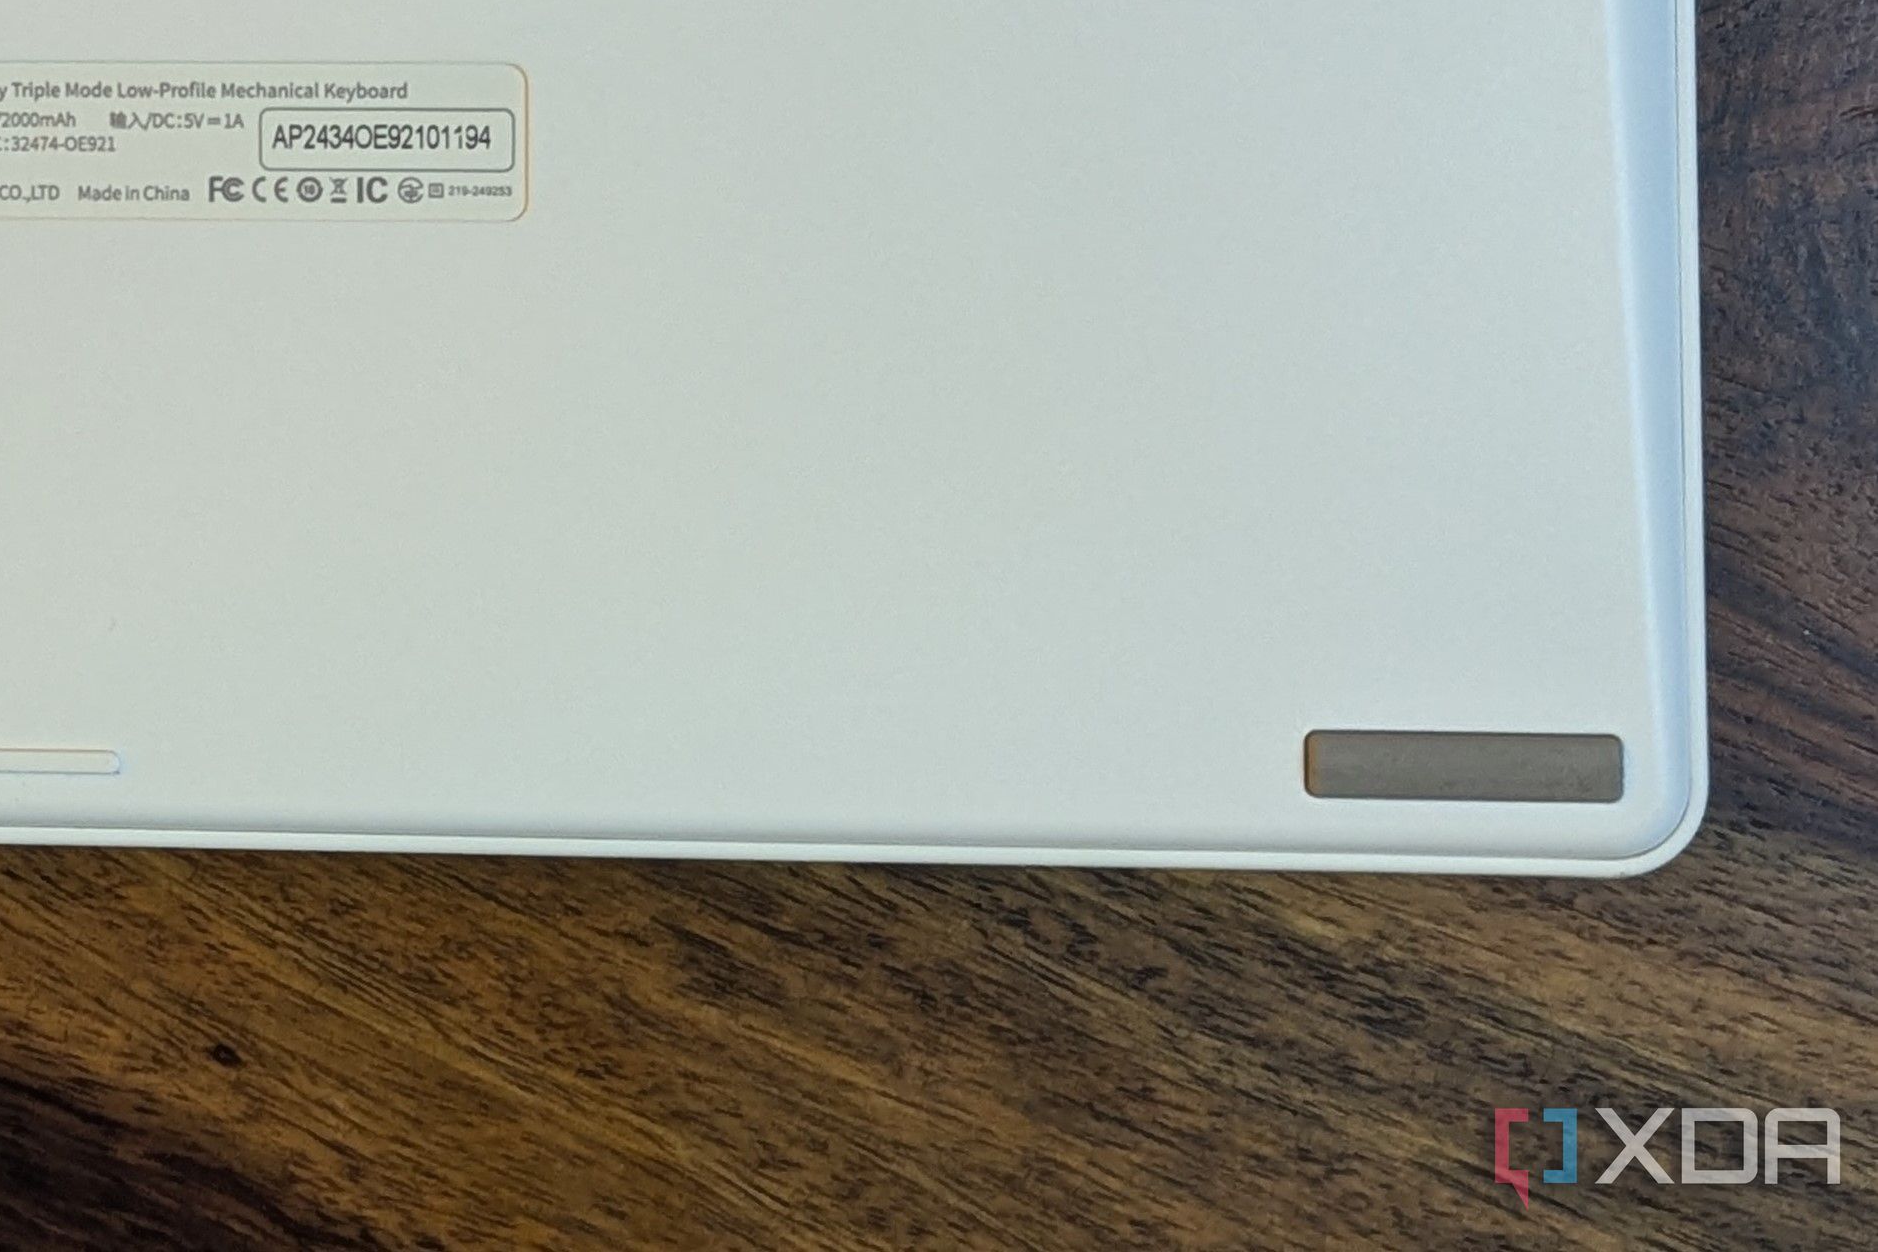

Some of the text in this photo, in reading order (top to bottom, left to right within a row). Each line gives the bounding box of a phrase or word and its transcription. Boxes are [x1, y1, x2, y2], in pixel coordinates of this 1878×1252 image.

[11, 81, 61, 102] Triple
[65, 81, 113, 99] Mode
[117, 81, 217, 99] Low-Profile
[221, 82, 319, 99] Mechanical
[324, 82, 409, 103] Keyboard
[273, 124, 491, 149] AP2434OE92101194
[78, 185, 190, 201] Made in China
[251, 176, 289, 203] CE
[356, 176, 388, 203] IC
